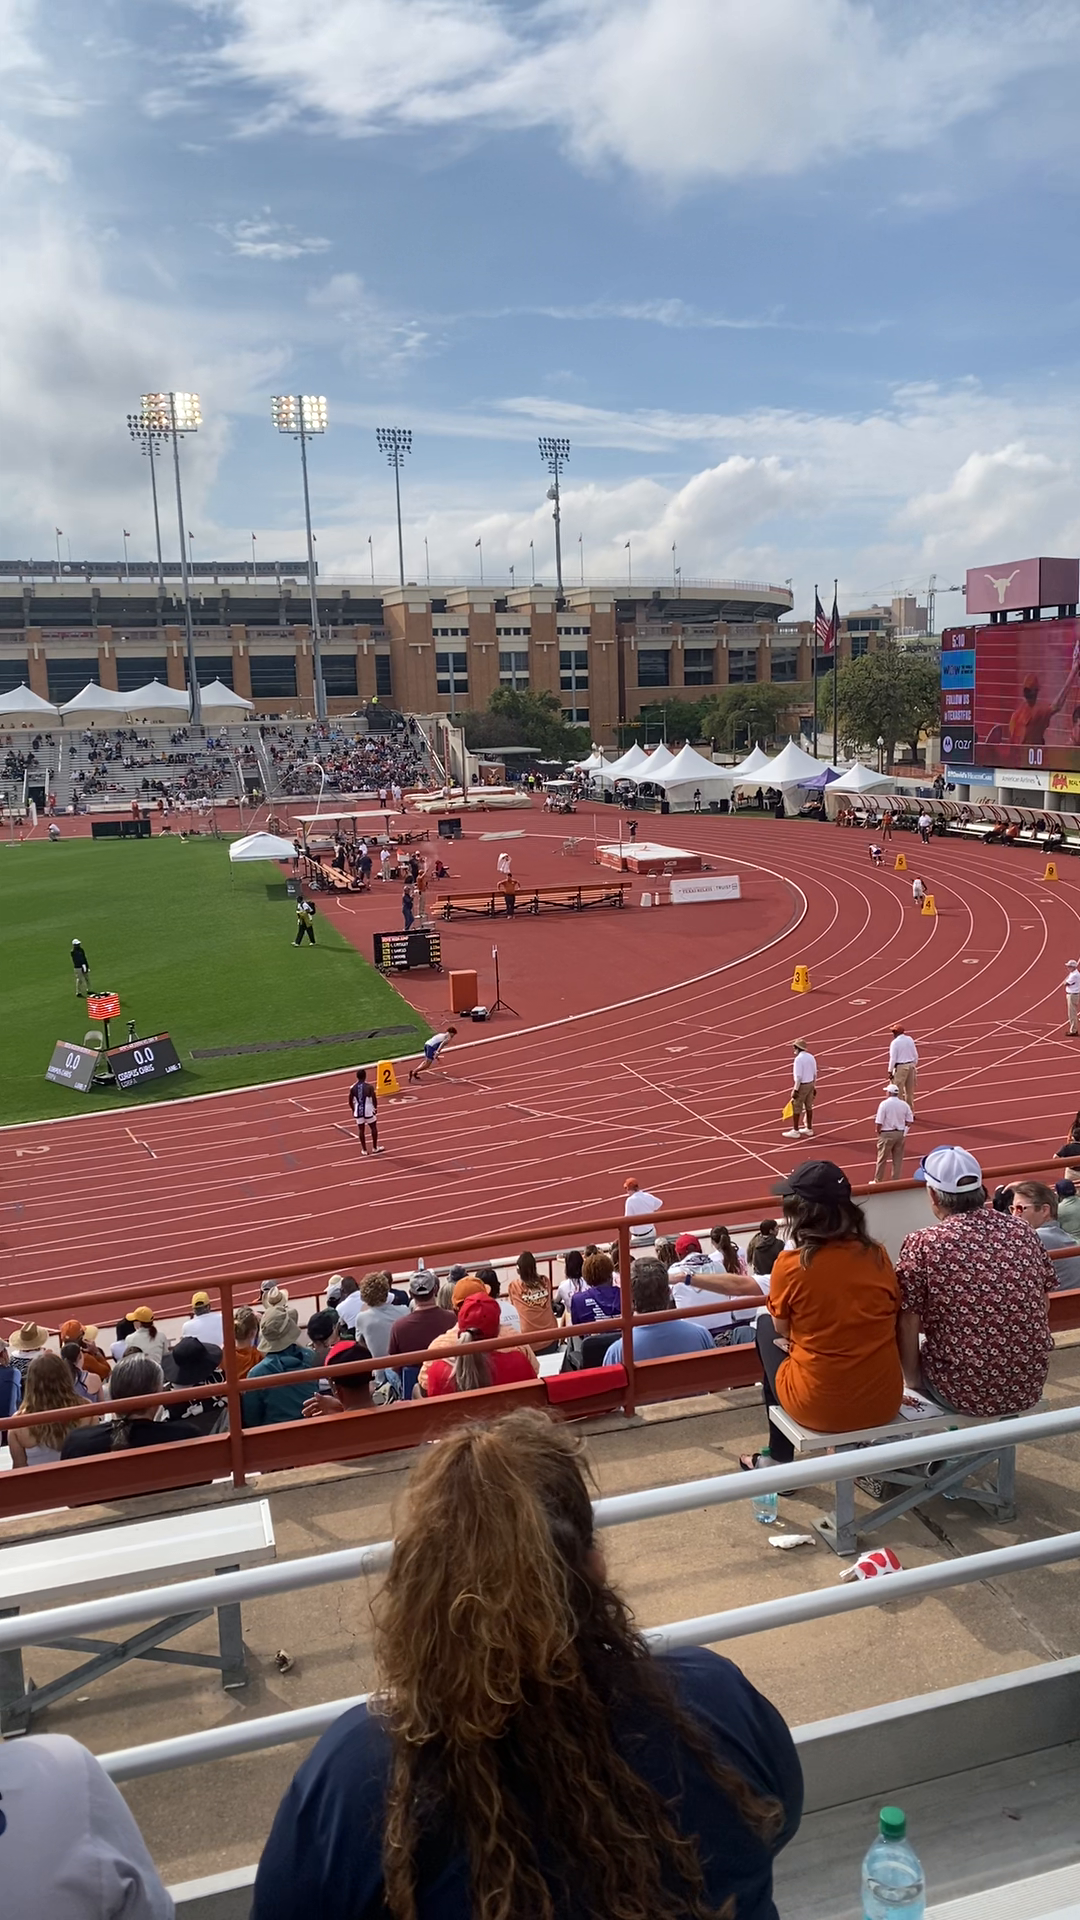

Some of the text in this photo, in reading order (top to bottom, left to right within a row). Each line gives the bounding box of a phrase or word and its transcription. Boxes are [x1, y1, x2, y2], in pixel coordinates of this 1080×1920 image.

[946, 694, 970, 704] FOLLOW US
[954, 740, 972, 750] razr
[1028, 748, 1043, 765] 0.0
[898, 858, 904, 866] 5
[1048, 866, 1054, 875] 9
[926, 900, 931, 909] 4
[794, 972, 800, 982] 3
[65, 1052, 80, 1070] 0.0
[134, 1047, 154, 1065] 0.0
[118, 1064, 154, 1082] CORPUS CHRIS
[383, 1070, 392, 1084] 2
[16, 1146, 50, 1156] 2
